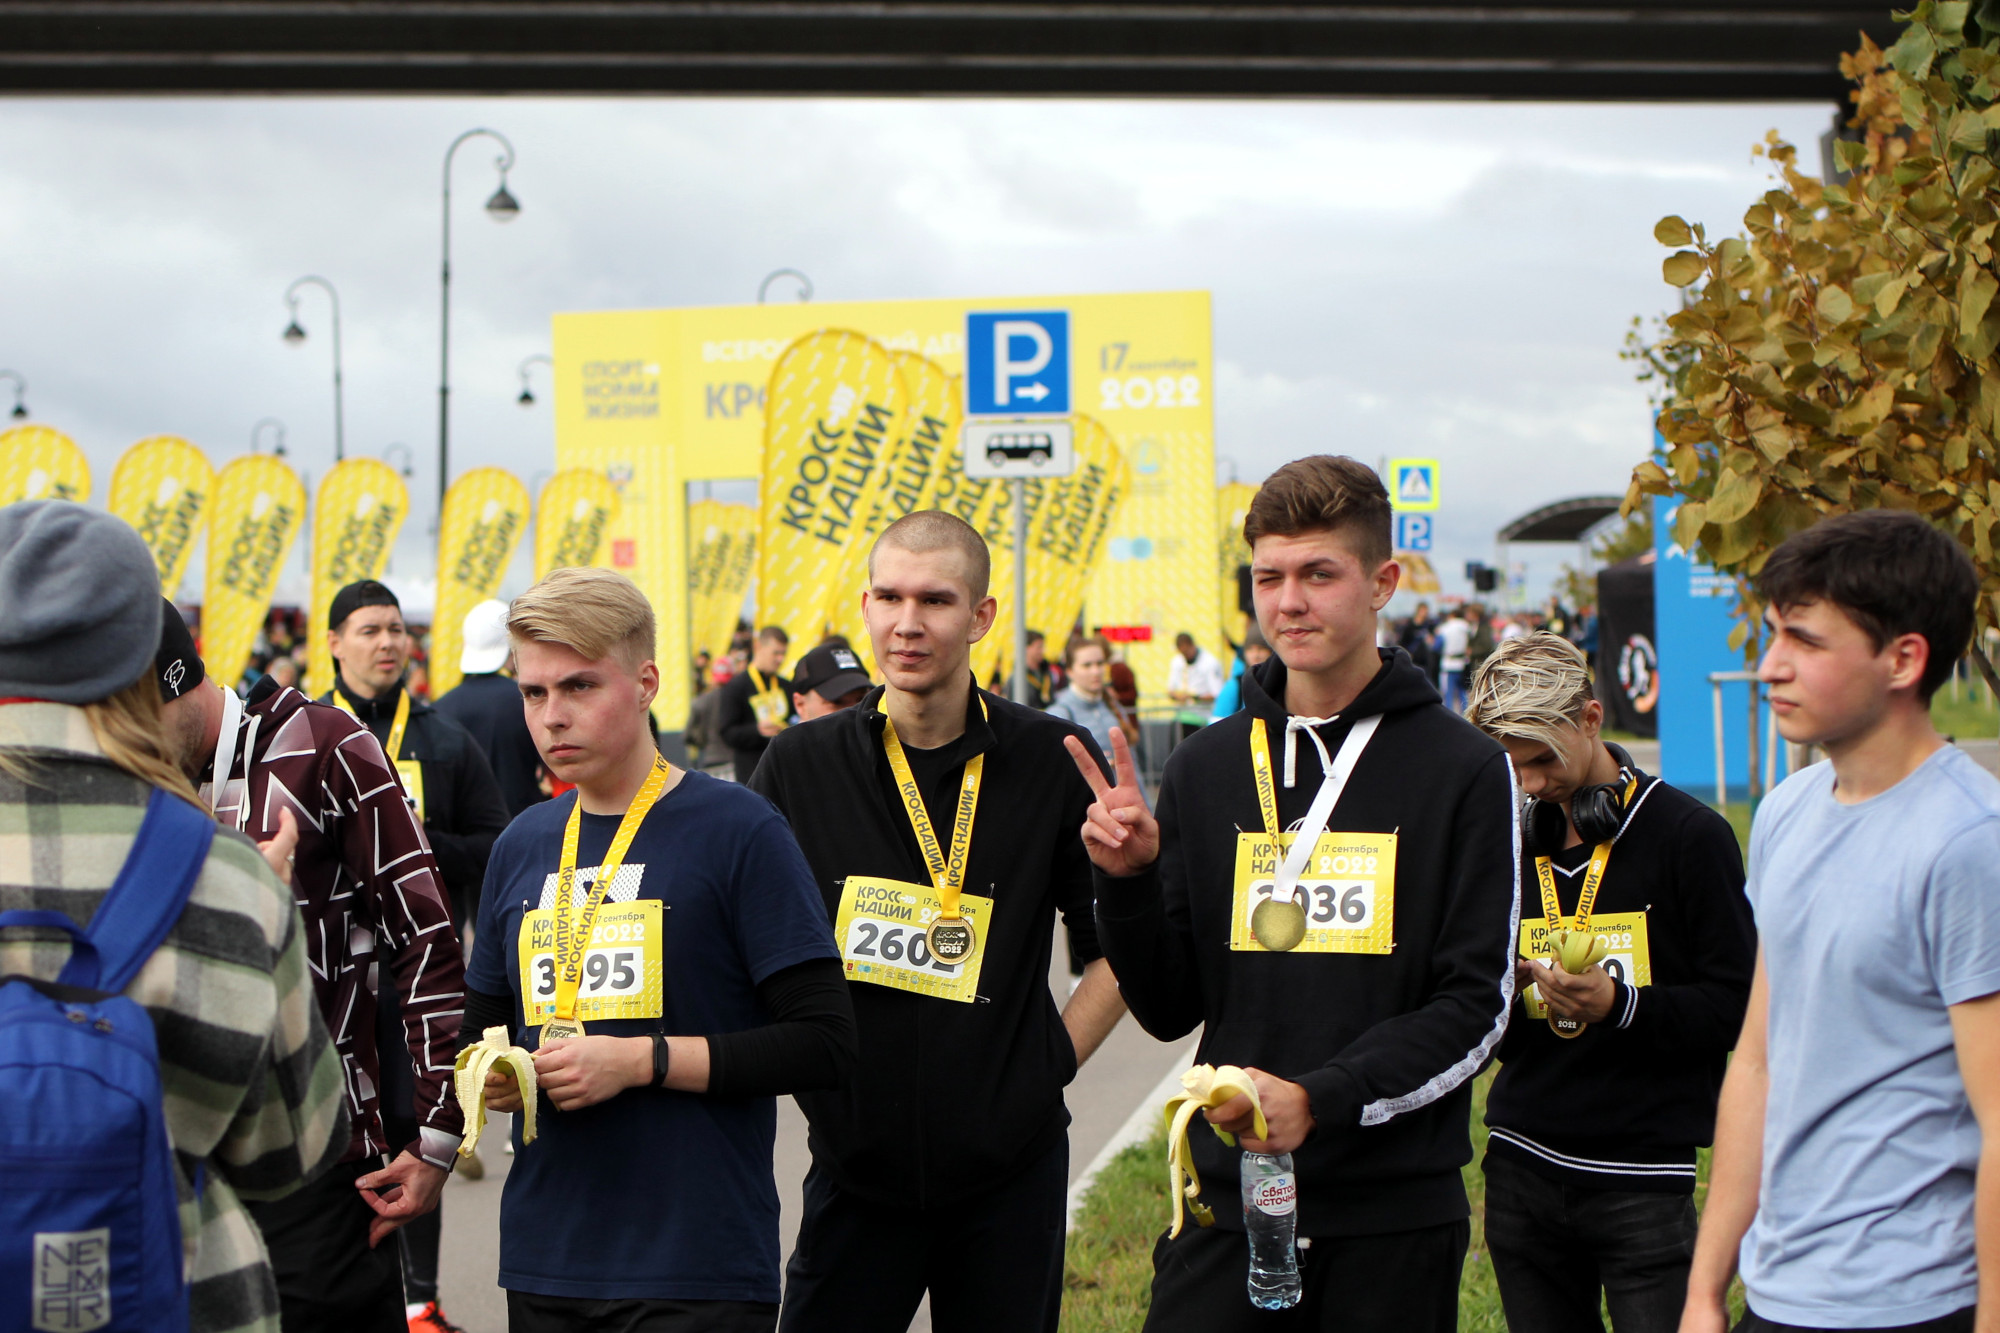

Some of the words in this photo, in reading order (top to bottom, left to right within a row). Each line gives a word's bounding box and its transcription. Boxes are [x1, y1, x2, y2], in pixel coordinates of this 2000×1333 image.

[994, 321, 1053, 406] P
[1099, 376, 1200, 410] 2022
[781, 417, 846, 532] КРОСС
[814, 402, 894, 546] НАЦИИ
[901, 781, 926, 822] КРОСС
[916, 821, 947, 874] НАЦИИ
[953, 789, 975, 844] НАЦИИ
[947, 845, 966, 887] КРОСС
[1318, 855, 1378, 875] 2022
[1331, 845, 1379, 854] сентября
[559, 865, 574, 906] КРОСС
[857, 886, 902, 904] КРОСС
[1538, 861, 1555, 900] КРОСС
[1576, 873, 1600, 926] НАЦИИ
[564, 936, 587, 983] КРОСС
[577, 879, 608, 936] НАЦИИ
[603, 911, 645, 923] сентября
[854, 900, 913, 921] НАЦИИ
[1594, 923, 1632, 933] сентября
[555, 906, 570, 965] НАЦИИ
[939, 945, 962, 954] 2022
[537, 952, 636, 996] 395
[1557, 1020, 1577, 1029] 2022
